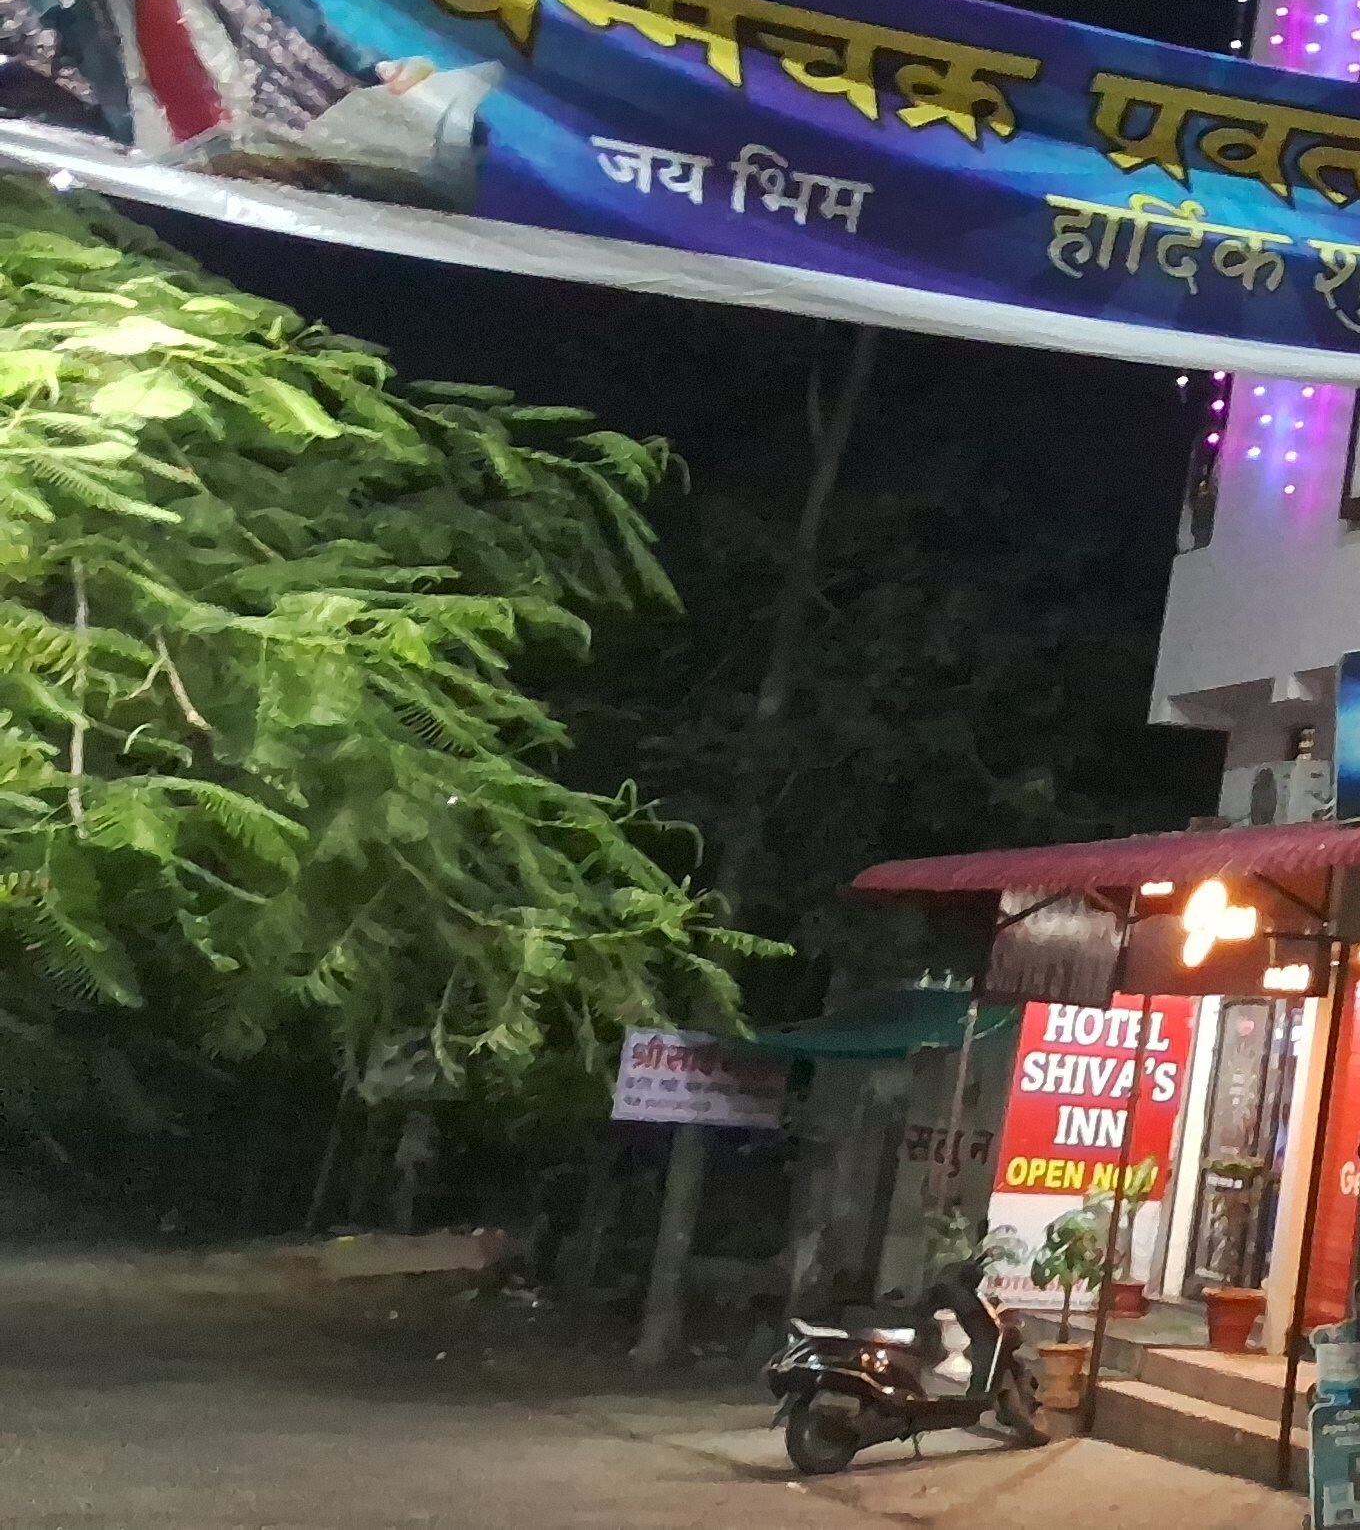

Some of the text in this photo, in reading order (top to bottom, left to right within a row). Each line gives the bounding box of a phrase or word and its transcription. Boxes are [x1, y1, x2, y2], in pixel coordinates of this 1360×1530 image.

[590, 136, 873, 233] जय भिम
[1046, 192, 1294, 295] हार्दिक
[1043, 1003, 1170, 1052] HOTEL
[1020, 1050, 1178, 1103] SHIVA'S
[1053, 1105, 1128, 1149] INN
[1006, 1155, 1086, 1190] OPEN
